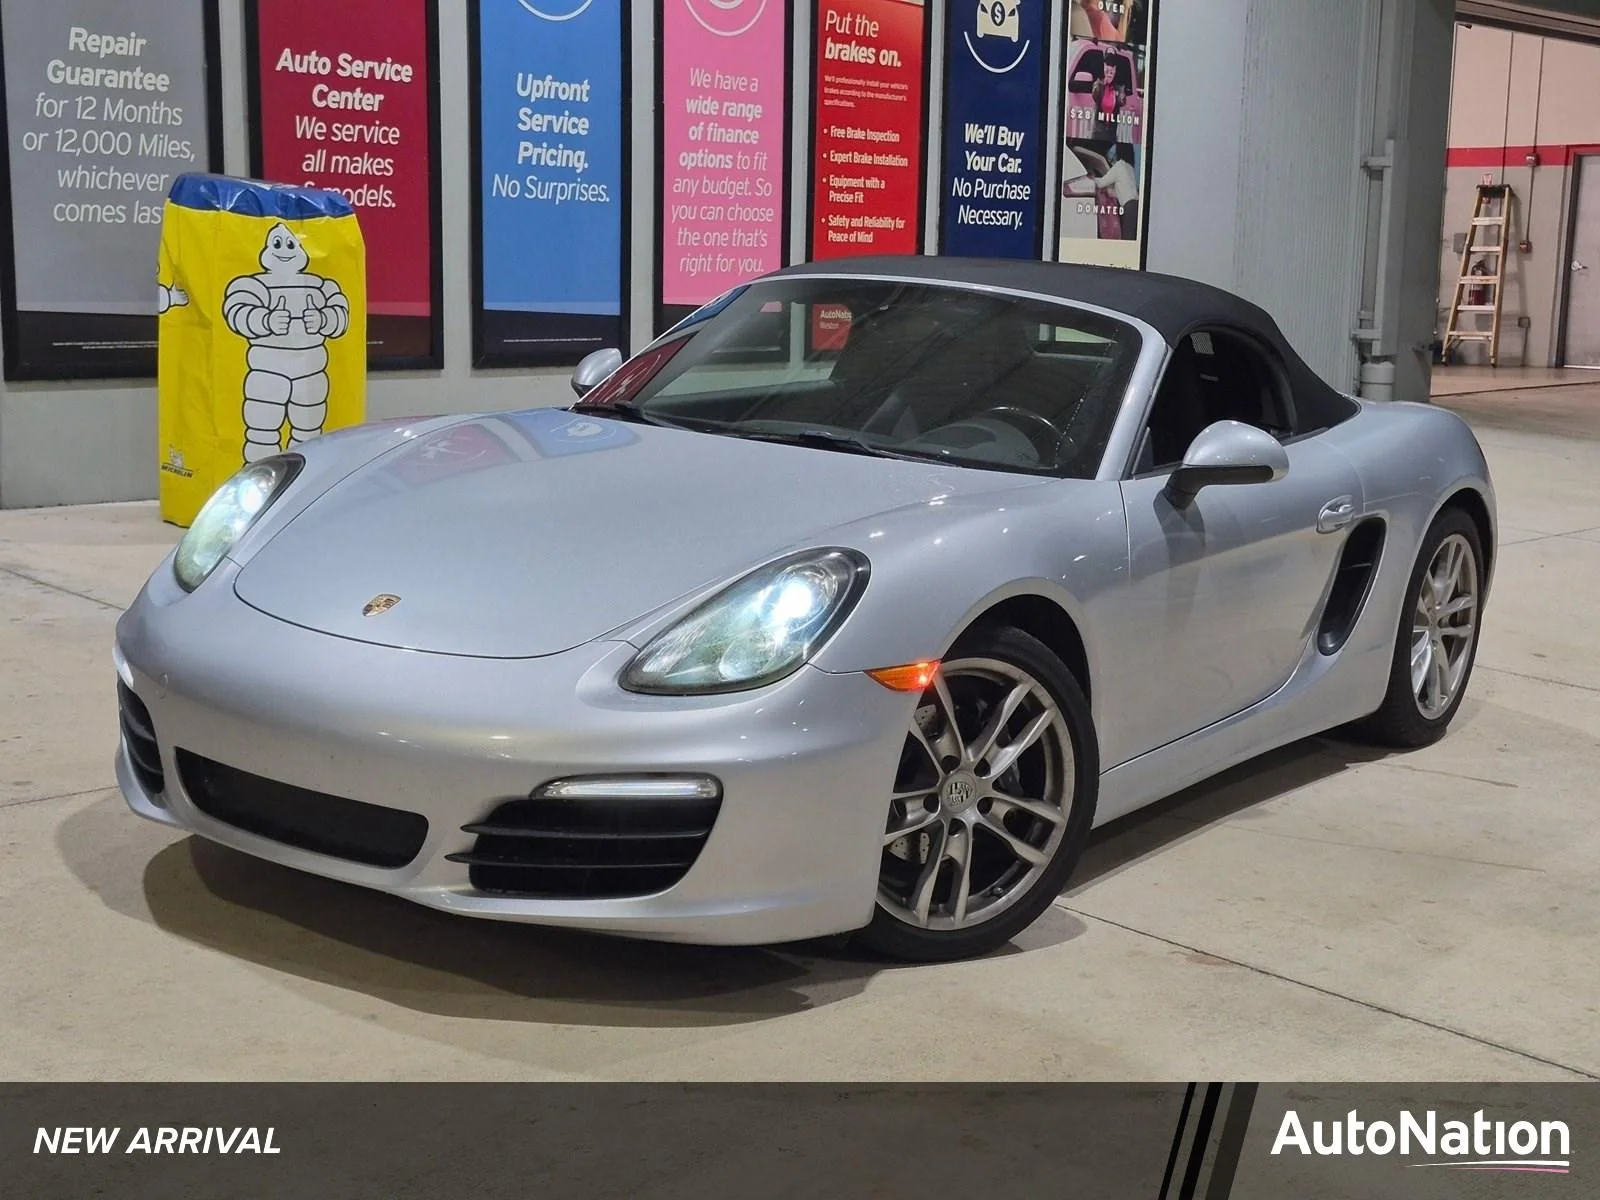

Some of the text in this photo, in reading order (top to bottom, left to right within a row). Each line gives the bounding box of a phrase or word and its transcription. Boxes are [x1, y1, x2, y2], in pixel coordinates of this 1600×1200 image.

[1098, 1, 1125, 14] OVER
[825, 9, 880, 38] Put the
[68, 26, 147, 58] Repair
[824, 36, 902, 68] brakes on.
[46, 59, 171, 92] Guarantee
[275, 47, 413, 83] Auto Service
[516, 72, 590, 103] Upfront
[690, 67, 759, 92] We have a
[35, 92, 184, 126] for 12 Months
[311, 83, 385, 112] Center
[686, 96, 763, 122] wide range
[295, 115, 401, 146] We service
[517, 106, 590, 136] Service
[1098, 111, 1140, 126] MILLION
[22, 128, 196, 162] or 12,000 Miles,
[688, 122, 760, 145] of finance
[830, 125, 900, 144] Free Brake Inspection
[964, 122, 1025, 151] We'll Buy
[302, 149, 394, 177] all makes
[517, 140, 590, 173] Pricing.
[679, 149, 768, 171] options to fit
[829, 150, 909, 168] Expert Brake Installation
[964, 150, 1023, 174] Your Car.
[57, 164, 169, 192] whichever
[492, 173, 610, 206] No Surprises.
[673, 175, 772, 200] any budget. So
[829, 174, 864, 190] Equipment
[865, 176, 880, 189] with
[951, 176, 1031, 201] No Purchase
[828, 190, 864, 204] Precise Fit
[53, 200, 163, 225] comes las
[671, 202, 774, 224] you can choose
[827, 214, 905, 231] Safety and Reliability for
[957, 204, 1023, 230] Necessary.
[1077, 204, 1125, 216] DONATED
[677, 227, 768, 248] the one that's
[827, 230, 874, 244] Peace of Mind
[680, 254, 765, 278] right for you.
